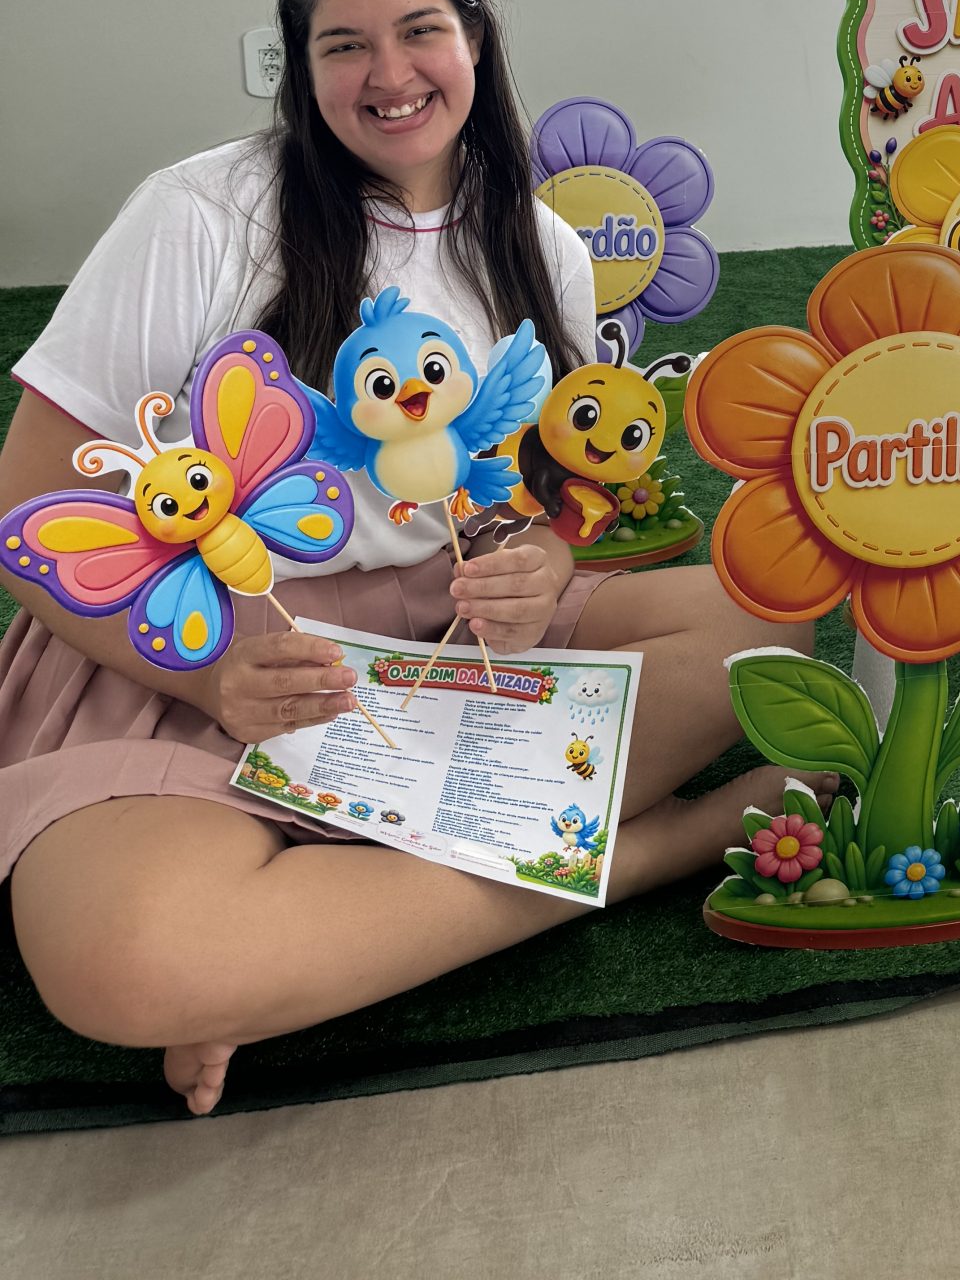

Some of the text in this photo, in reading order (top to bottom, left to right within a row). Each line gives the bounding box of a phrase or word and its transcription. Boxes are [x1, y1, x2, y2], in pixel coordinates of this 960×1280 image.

[389, 665, 541, 694] O JADIM DA AMIZADE
